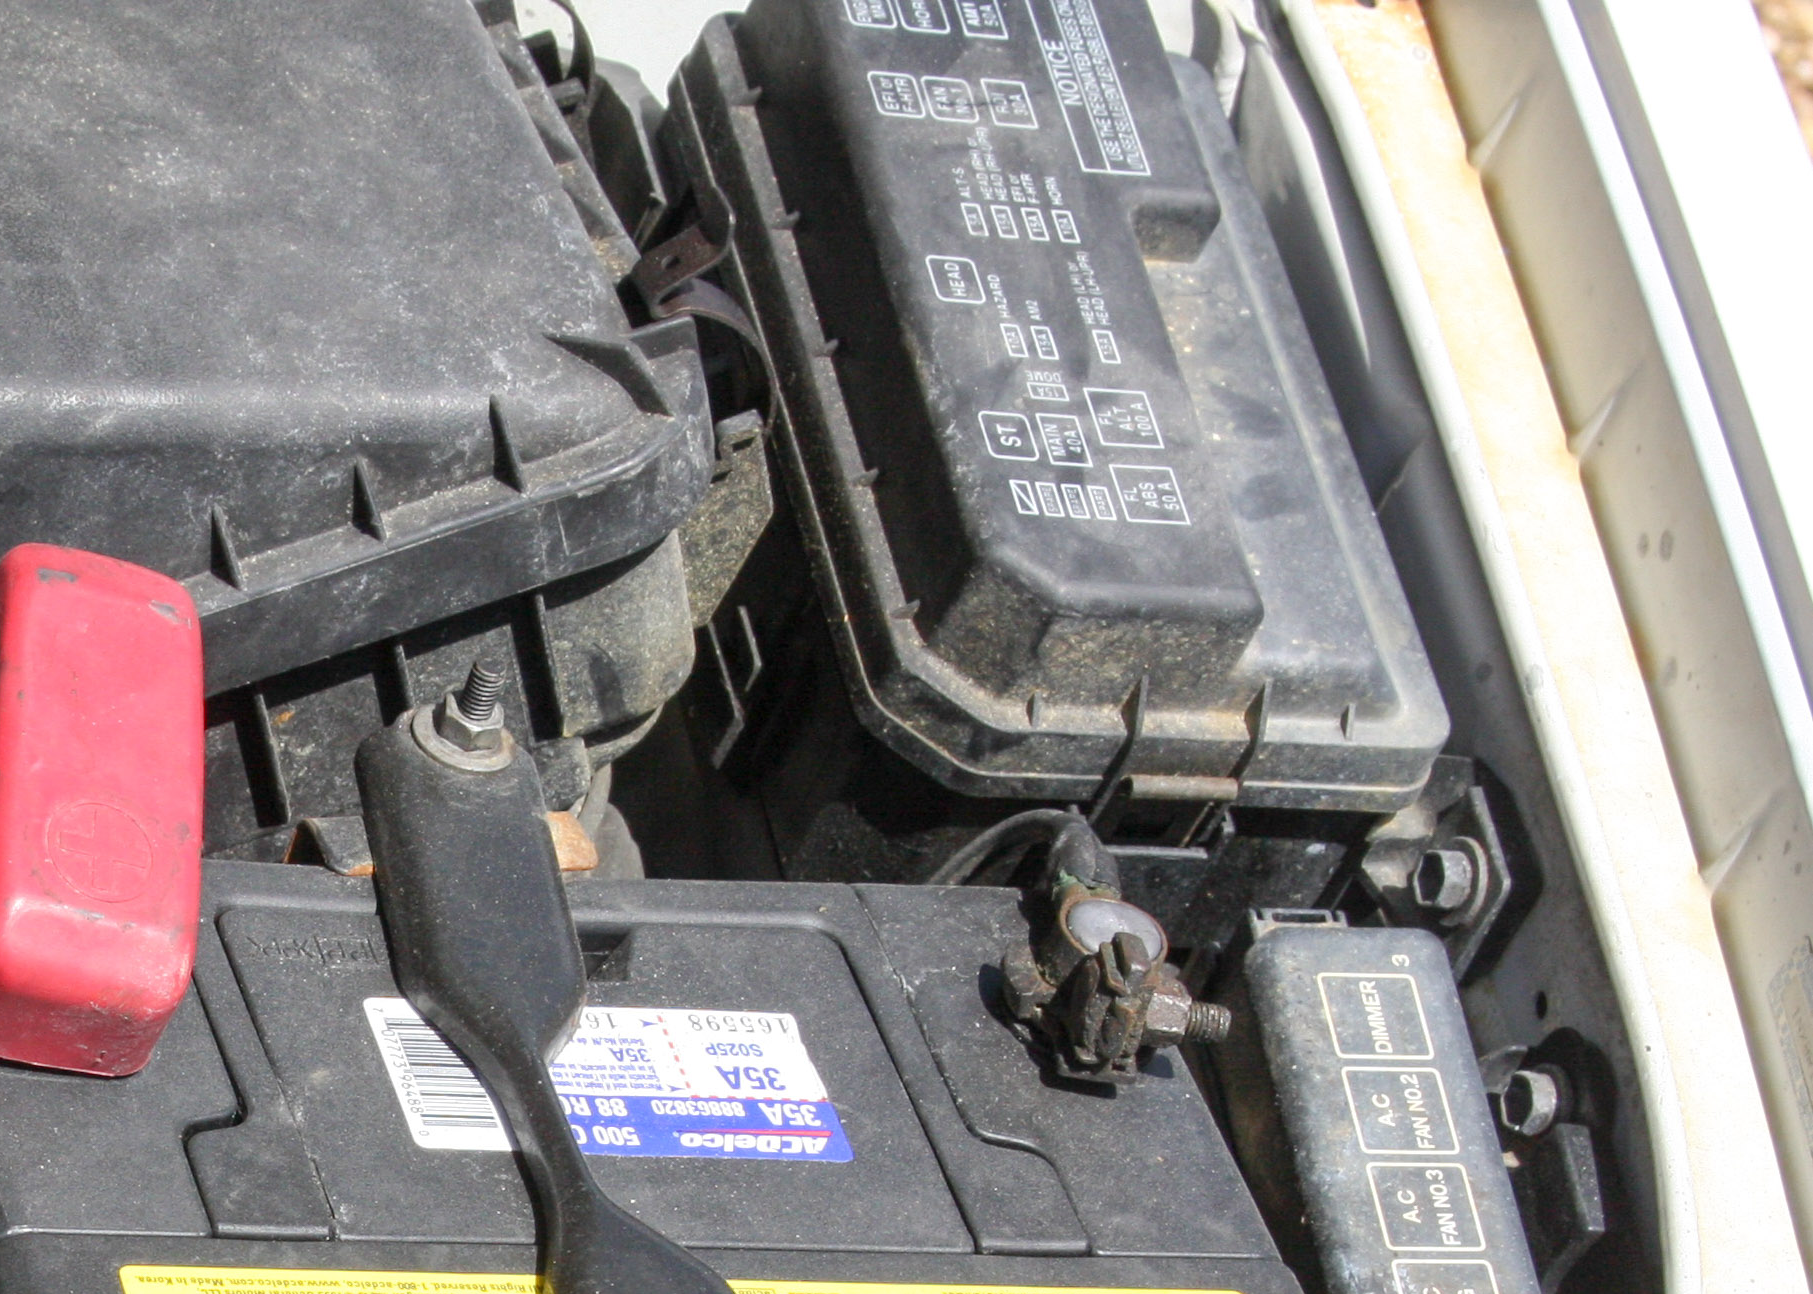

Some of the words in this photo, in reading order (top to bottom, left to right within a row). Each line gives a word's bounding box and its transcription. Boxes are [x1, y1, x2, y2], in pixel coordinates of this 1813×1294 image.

[1043, 39, 1083, 106] NOTICE
[880, 88, 900, 112] EFI
[894, 77, 917, 113] F-HTR
[931, 86, 951, 112] FAN
[1095, 117, 1115, 138] THE
[1104, 139, 1124, 161] USE
[952, 167, 971, 199] ALT-S
[975, 173, 994, 200] HEAD
[990, 173, 1008, 201] HEAD
[1011, 187, 1027, 203] EFI
[1020, 172, 1040, 204] F-HTR
[1044, 175, 1064, 206] HORN
[944, 261, 968, 297] HEAD
[987, 274, 1011, 318] HAZARD
[1025, 300, 1043, 321] AM2
[1076, 296, 1096, 325] HEAD
[1091, 297, 1112, 326] HEAD
[1024, 370, 1062, 383] DOME
[1098, 409, 1114, 426] FL
[1113, 406, 1135, 432] ALT
[1130, 402, 1144, 411] A
[995, 423, 1022, 448] ST
[1134, 415, 1155, 437] 100
[1044, 423, 1066, 457] MAIN
[1065, 429, 1083, 454] 40A
[1124, 487, 1140, 502] FL
[1139, 482, 1161, 509] ABS
[1158, 482, 1173, 491] A
[1161, 494, 1180, 511] 50
[1391, 954, 1410, 967] 3
[688, 1013, 790, 1035] 165598
[1359, 980, 1393, 1053] DIMMER
[609, 1048, 651, 1062] 35A
[705, 1042, 764, 1057] S025P
[714, 1066, 786, 1091] 35A
[1400, 1073, 1426, 1112] NO.2
[594, 1099, 629, 1117] 88
[650, 1099, 746, 1117] 88863820
[758, 1103, 821, 1127] 35A
[1372, 1093, 1396, 1127] A.C
[592, 1126, 641, 1146] 500
[679, 1133, 828, 1155] ACDelco
[1411, 1117, 1436, 1149] FAN
[1425, 1169, 1451, 1208] NO.3
[1397, 1190, 1422, 1223] A.C
[1436, 1213, 1461, 1245] FAN
